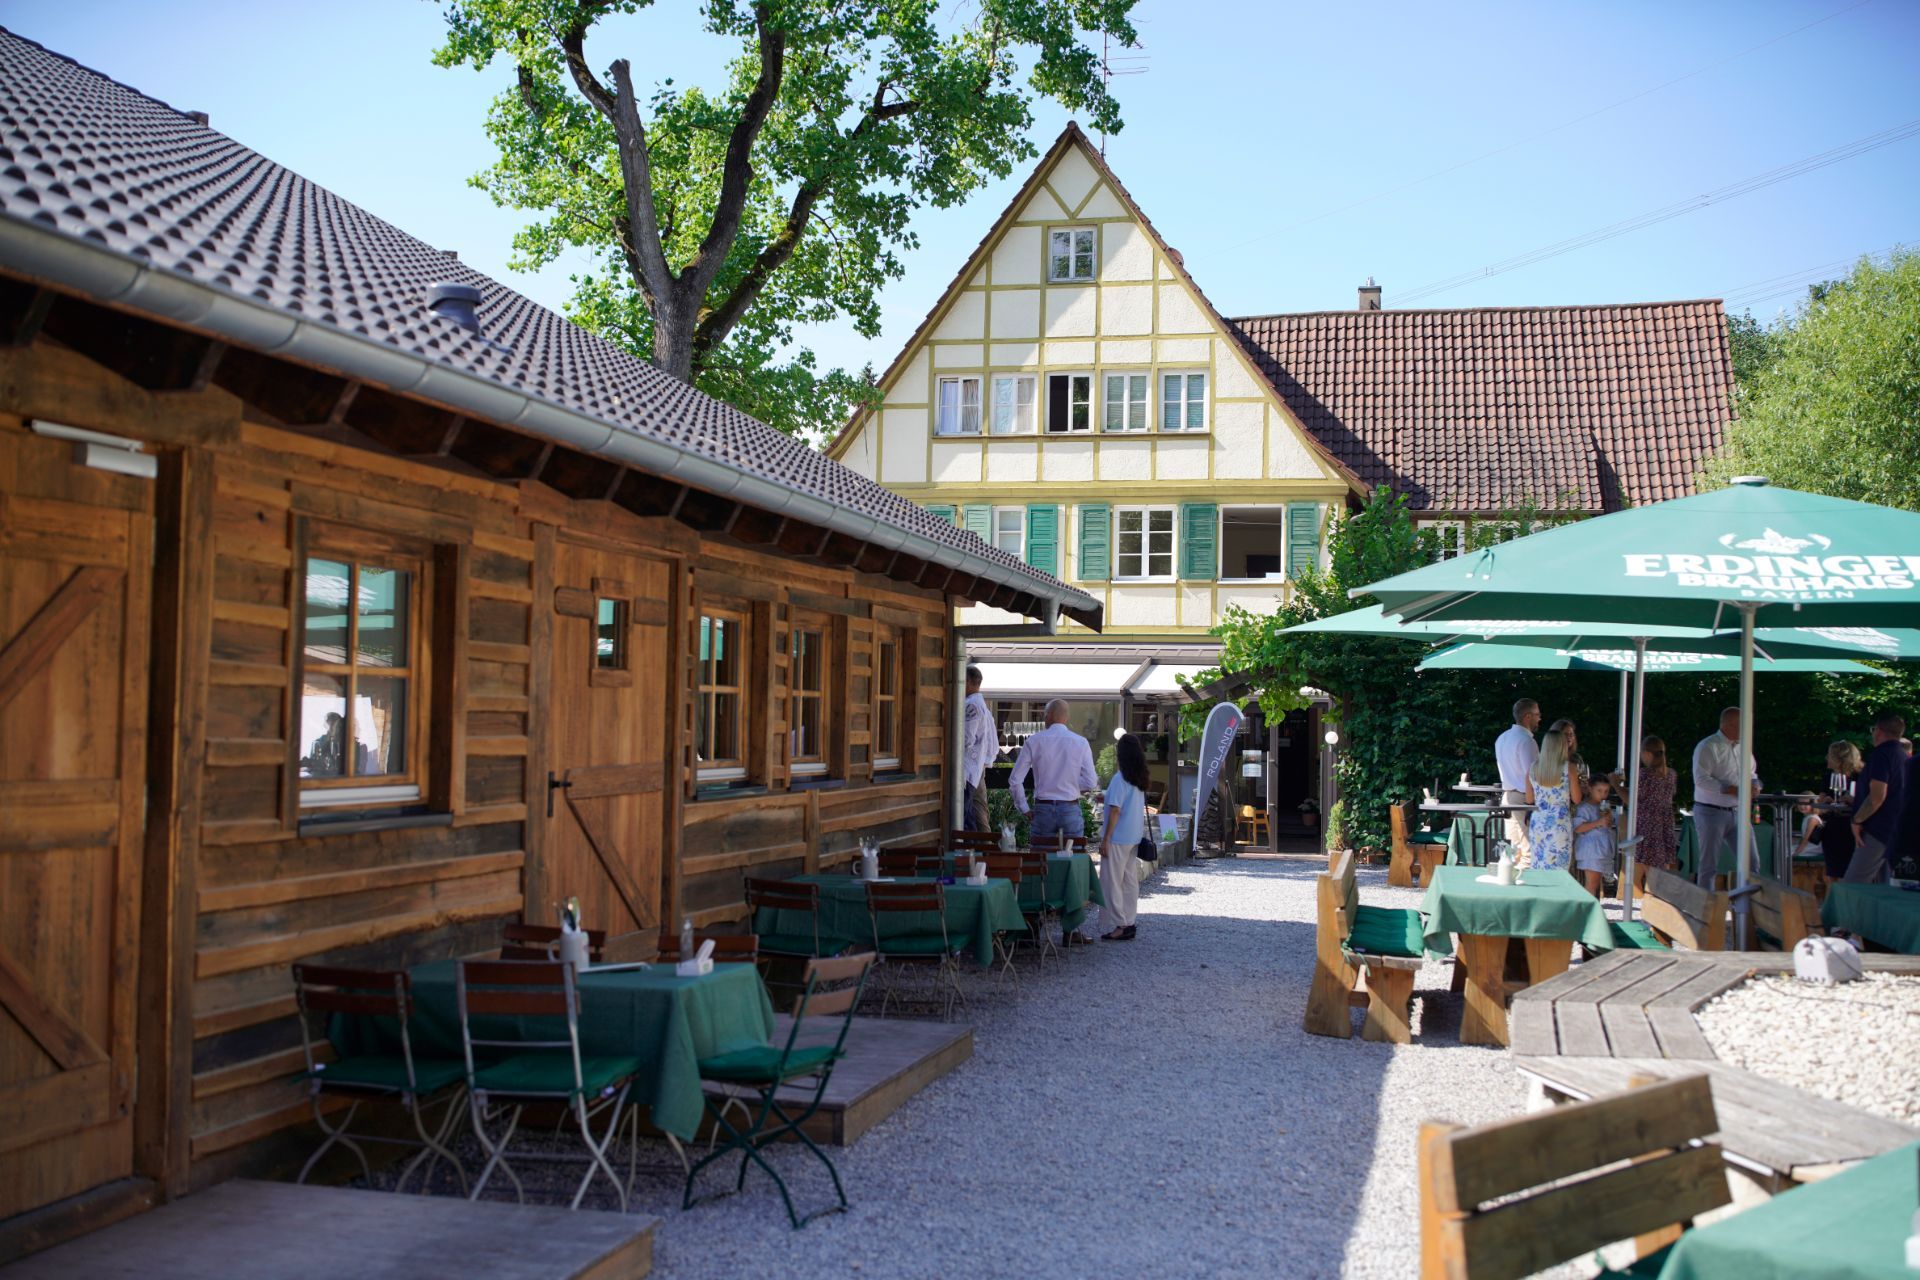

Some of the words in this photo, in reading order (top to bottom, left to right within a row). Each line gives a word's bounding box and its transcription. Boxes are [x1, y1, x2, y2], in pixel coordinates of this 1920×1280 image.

[1677, 572, 1915, 591] BRAUHAUS
[1740, 588, 1855, 600] BAYERN
[1206, 726, 1233, 778] ROLAND
